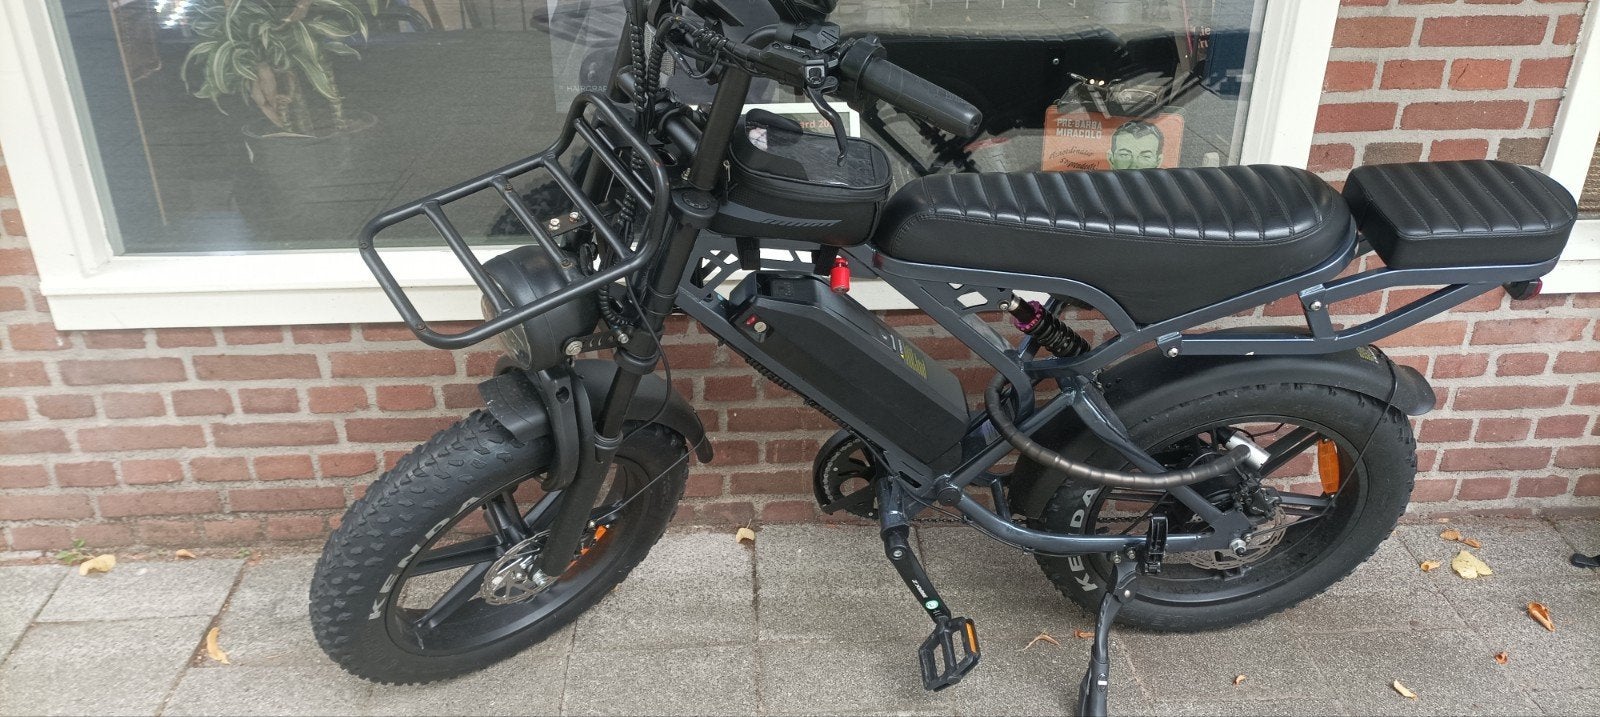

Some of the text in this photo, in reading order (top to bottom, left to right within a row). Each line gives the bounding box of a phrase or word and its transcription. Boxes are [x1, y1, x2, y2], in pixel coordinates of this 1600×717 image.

[818, 119, 833, 128] 20
[1055, 128, 1102, 139] MIRACOLO
[1067, 487, 1099, 592] KEDA
